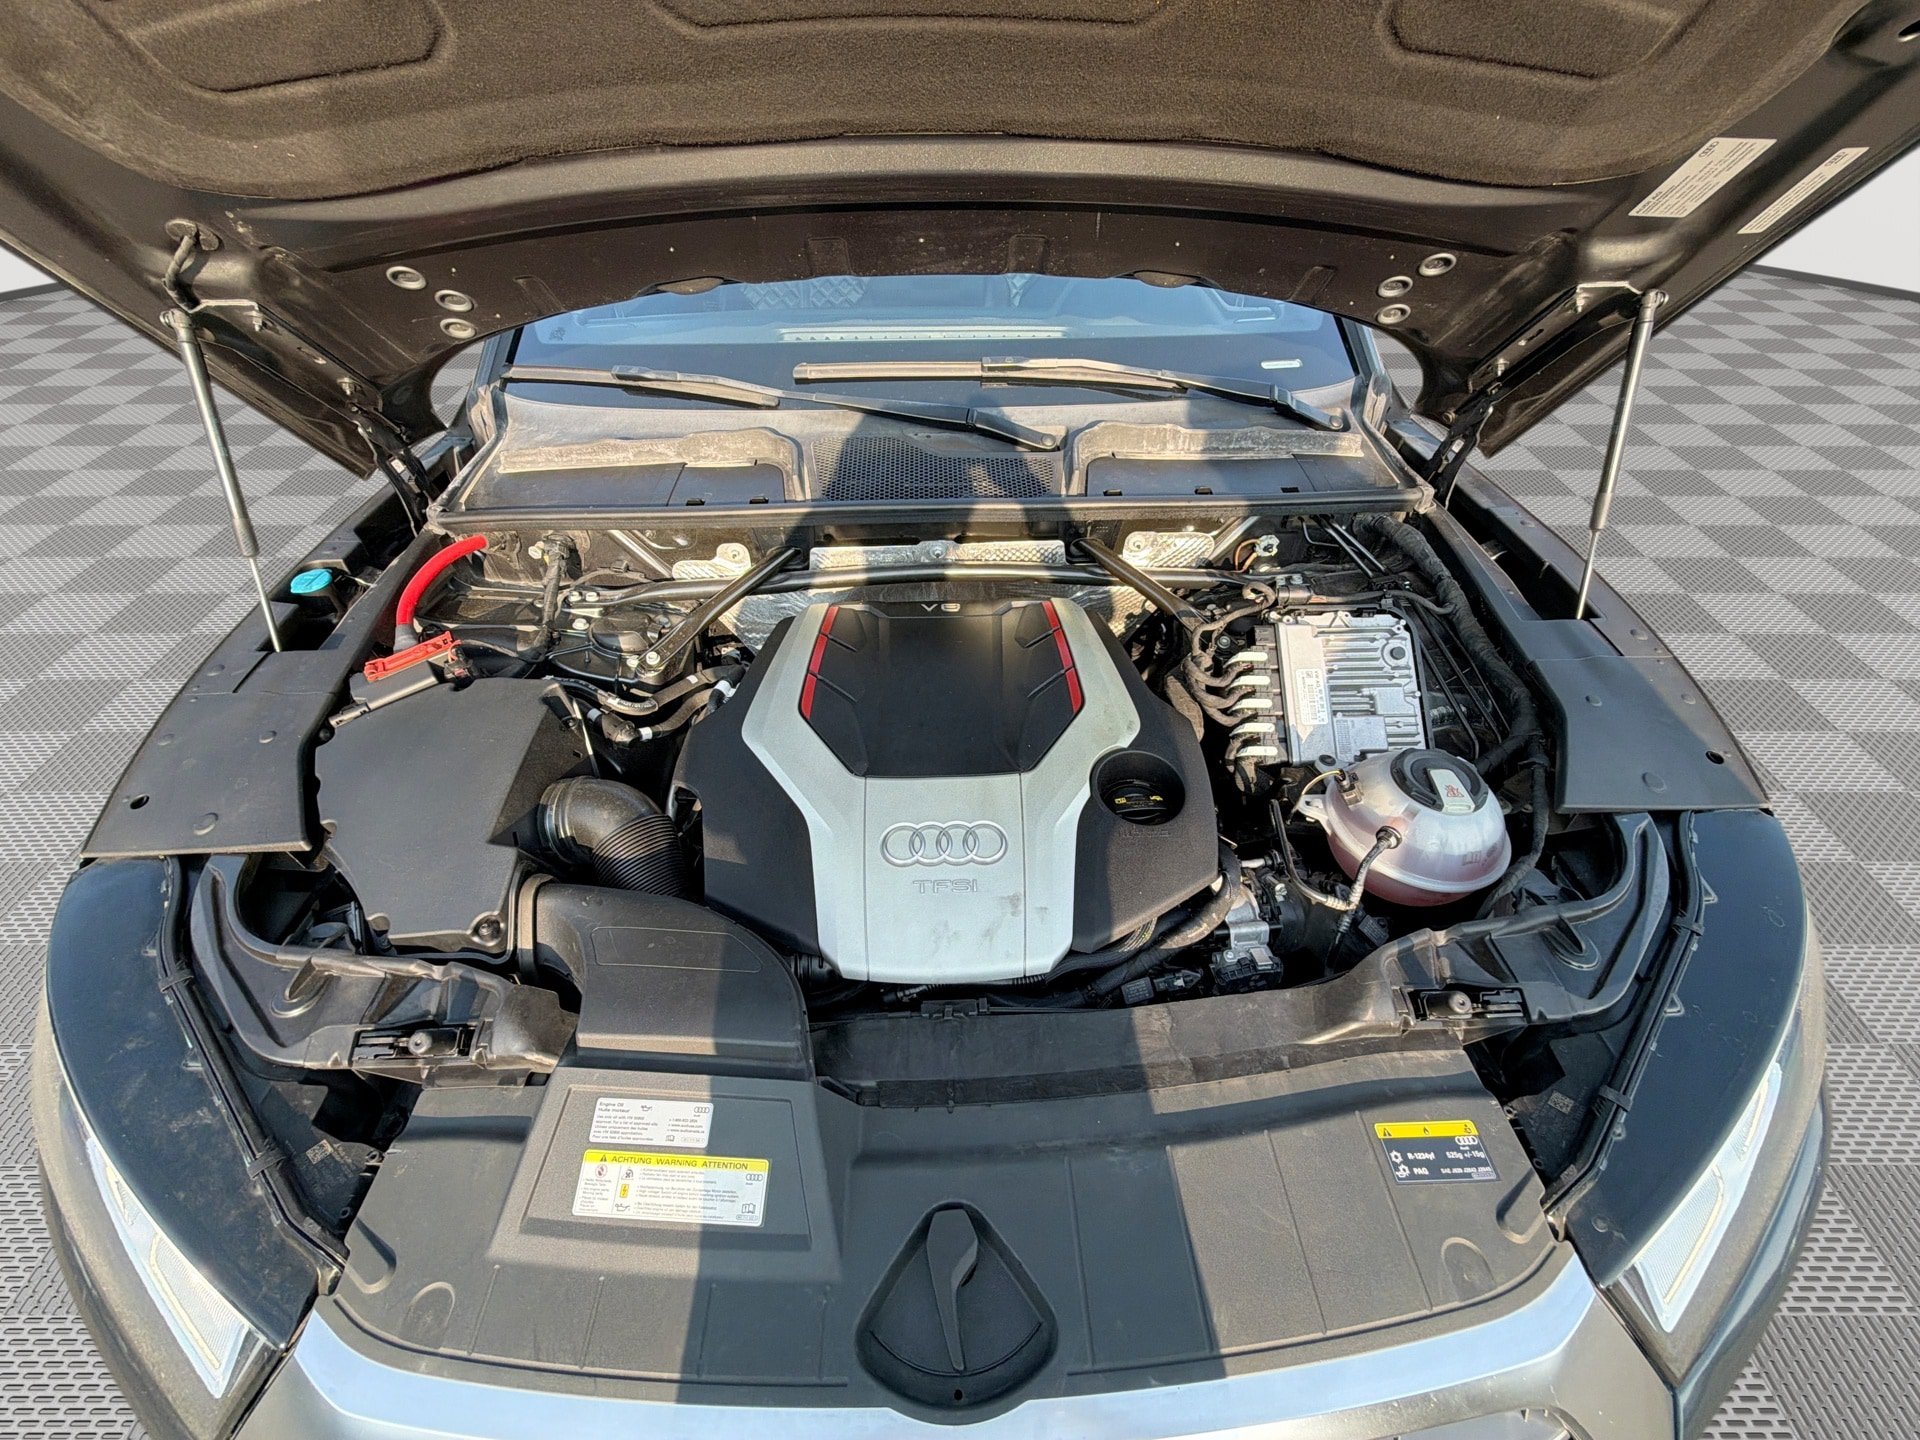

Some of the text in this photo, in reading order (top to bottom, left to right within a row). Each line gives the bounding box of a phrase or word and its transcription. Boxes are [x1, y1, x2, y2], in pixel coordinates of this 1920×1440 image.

[913, 879, 978, 894] TFSI
[612, 1155, 748, 1170] ACHTUNG WARNING ATTENTION
